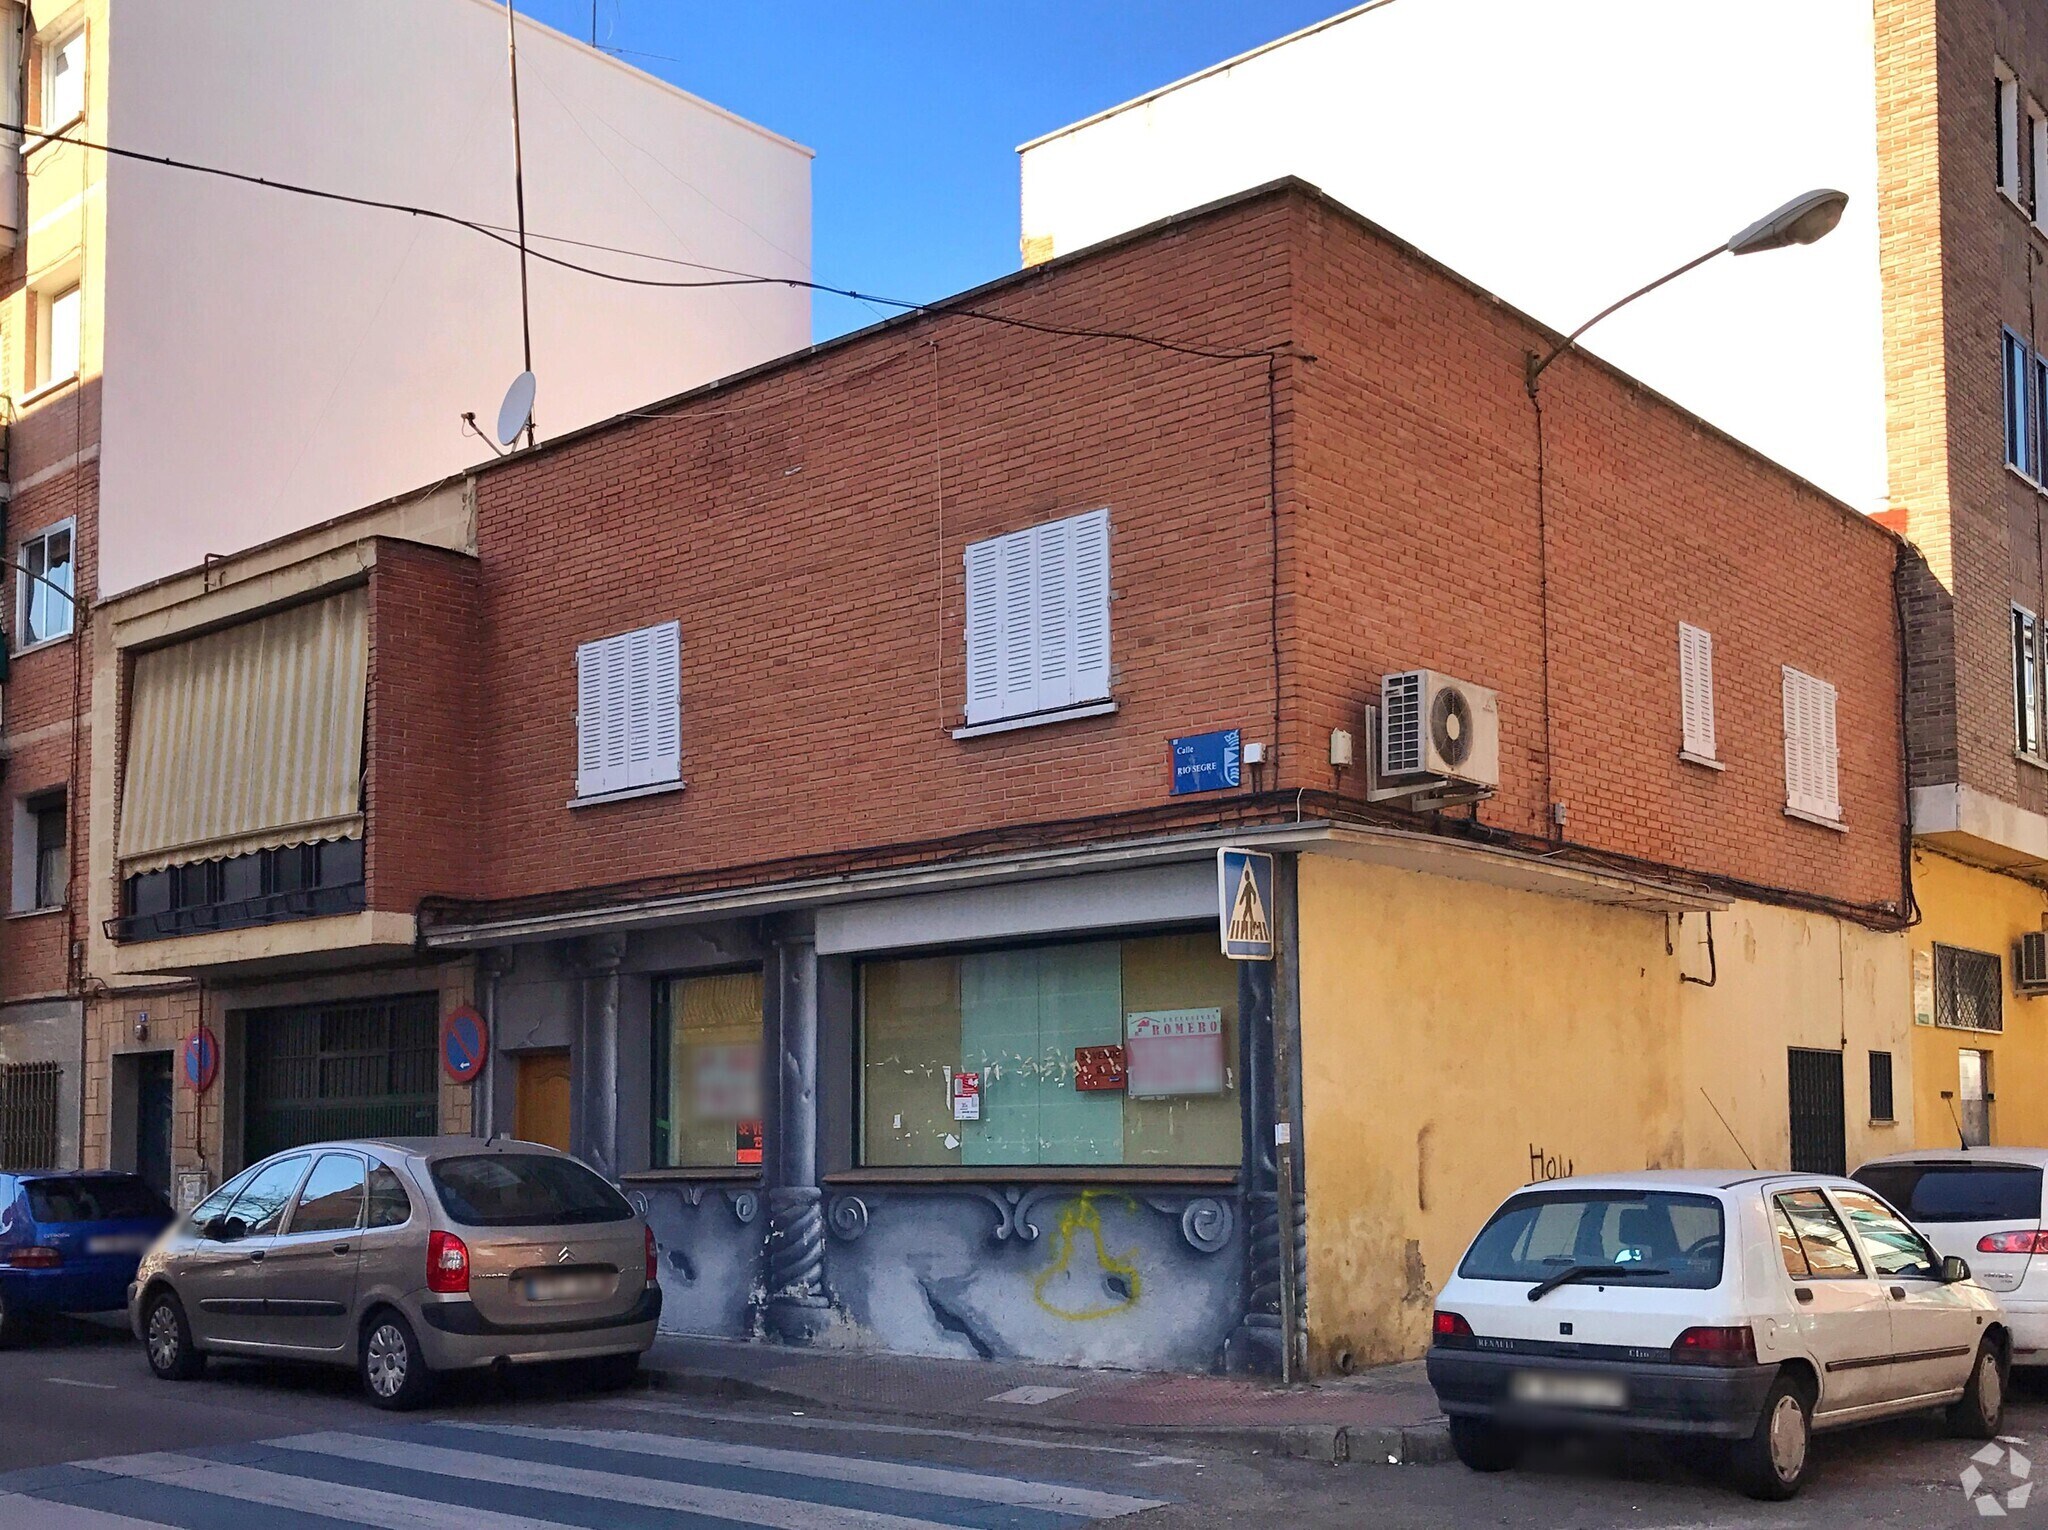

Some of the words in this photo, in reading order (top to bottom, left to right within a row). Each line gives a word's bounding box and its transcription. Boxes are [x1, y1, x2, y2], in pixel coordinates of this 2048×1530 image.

[1176, 745, 1194, 755] Calle
[1177, 767, 1191, 776] RIO
[1192, 762, 1217, 773] SEGRE
[1152, 1021, 1217, 1036] ROMERO
[1478, 1339, 1514, 1349] RENAULT
